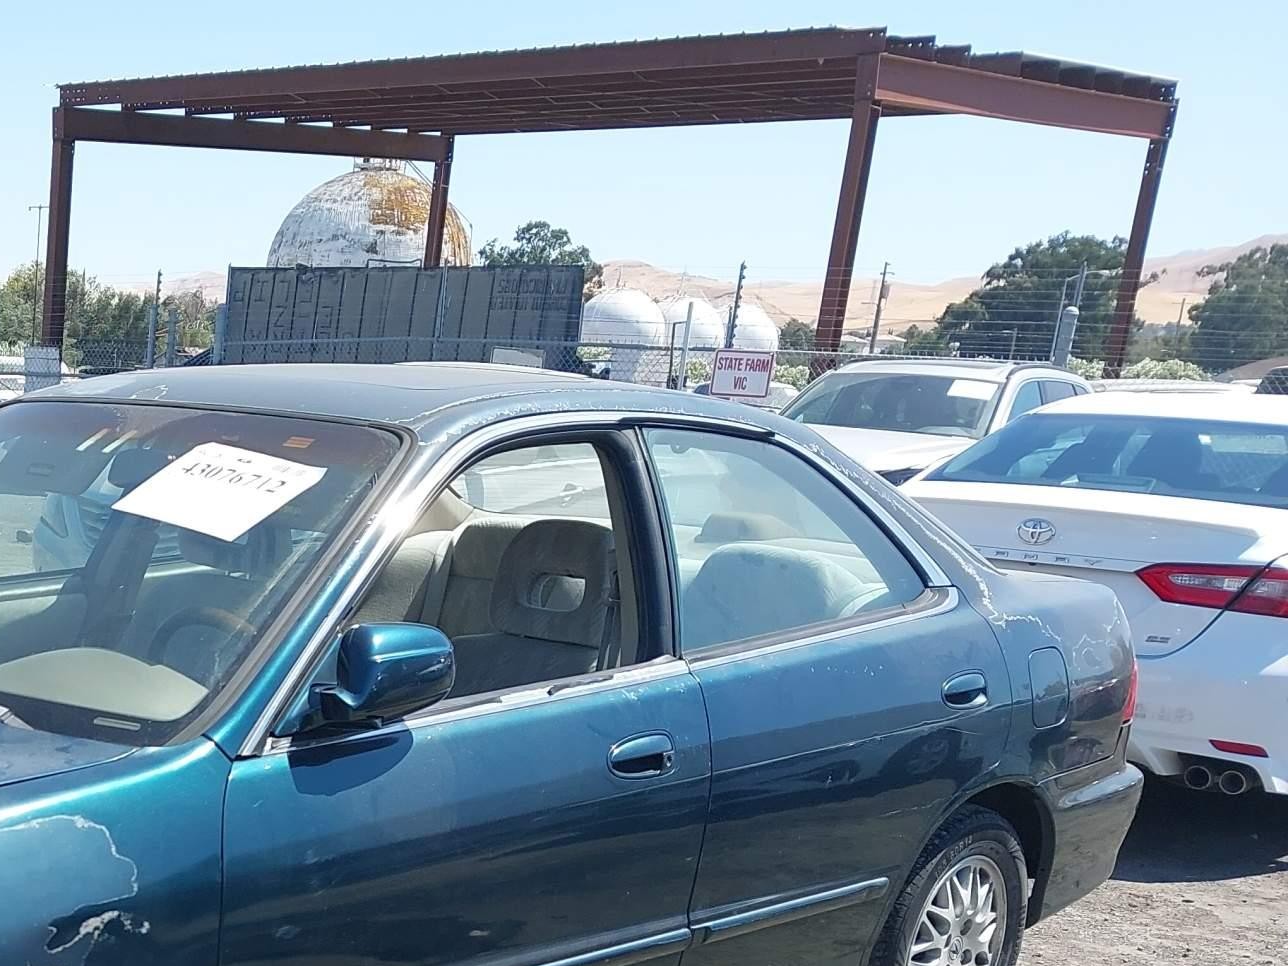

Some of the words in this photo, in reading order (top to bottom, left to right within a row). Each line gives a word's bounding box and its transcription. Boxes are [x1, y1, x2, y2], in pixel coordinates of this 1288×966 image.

[718, 357, 744, 371] STATE
[744, 358, 770, 373] FARM
[733, 376, 748, 391] VIC
[182, 462, 287, 493] 43076712
